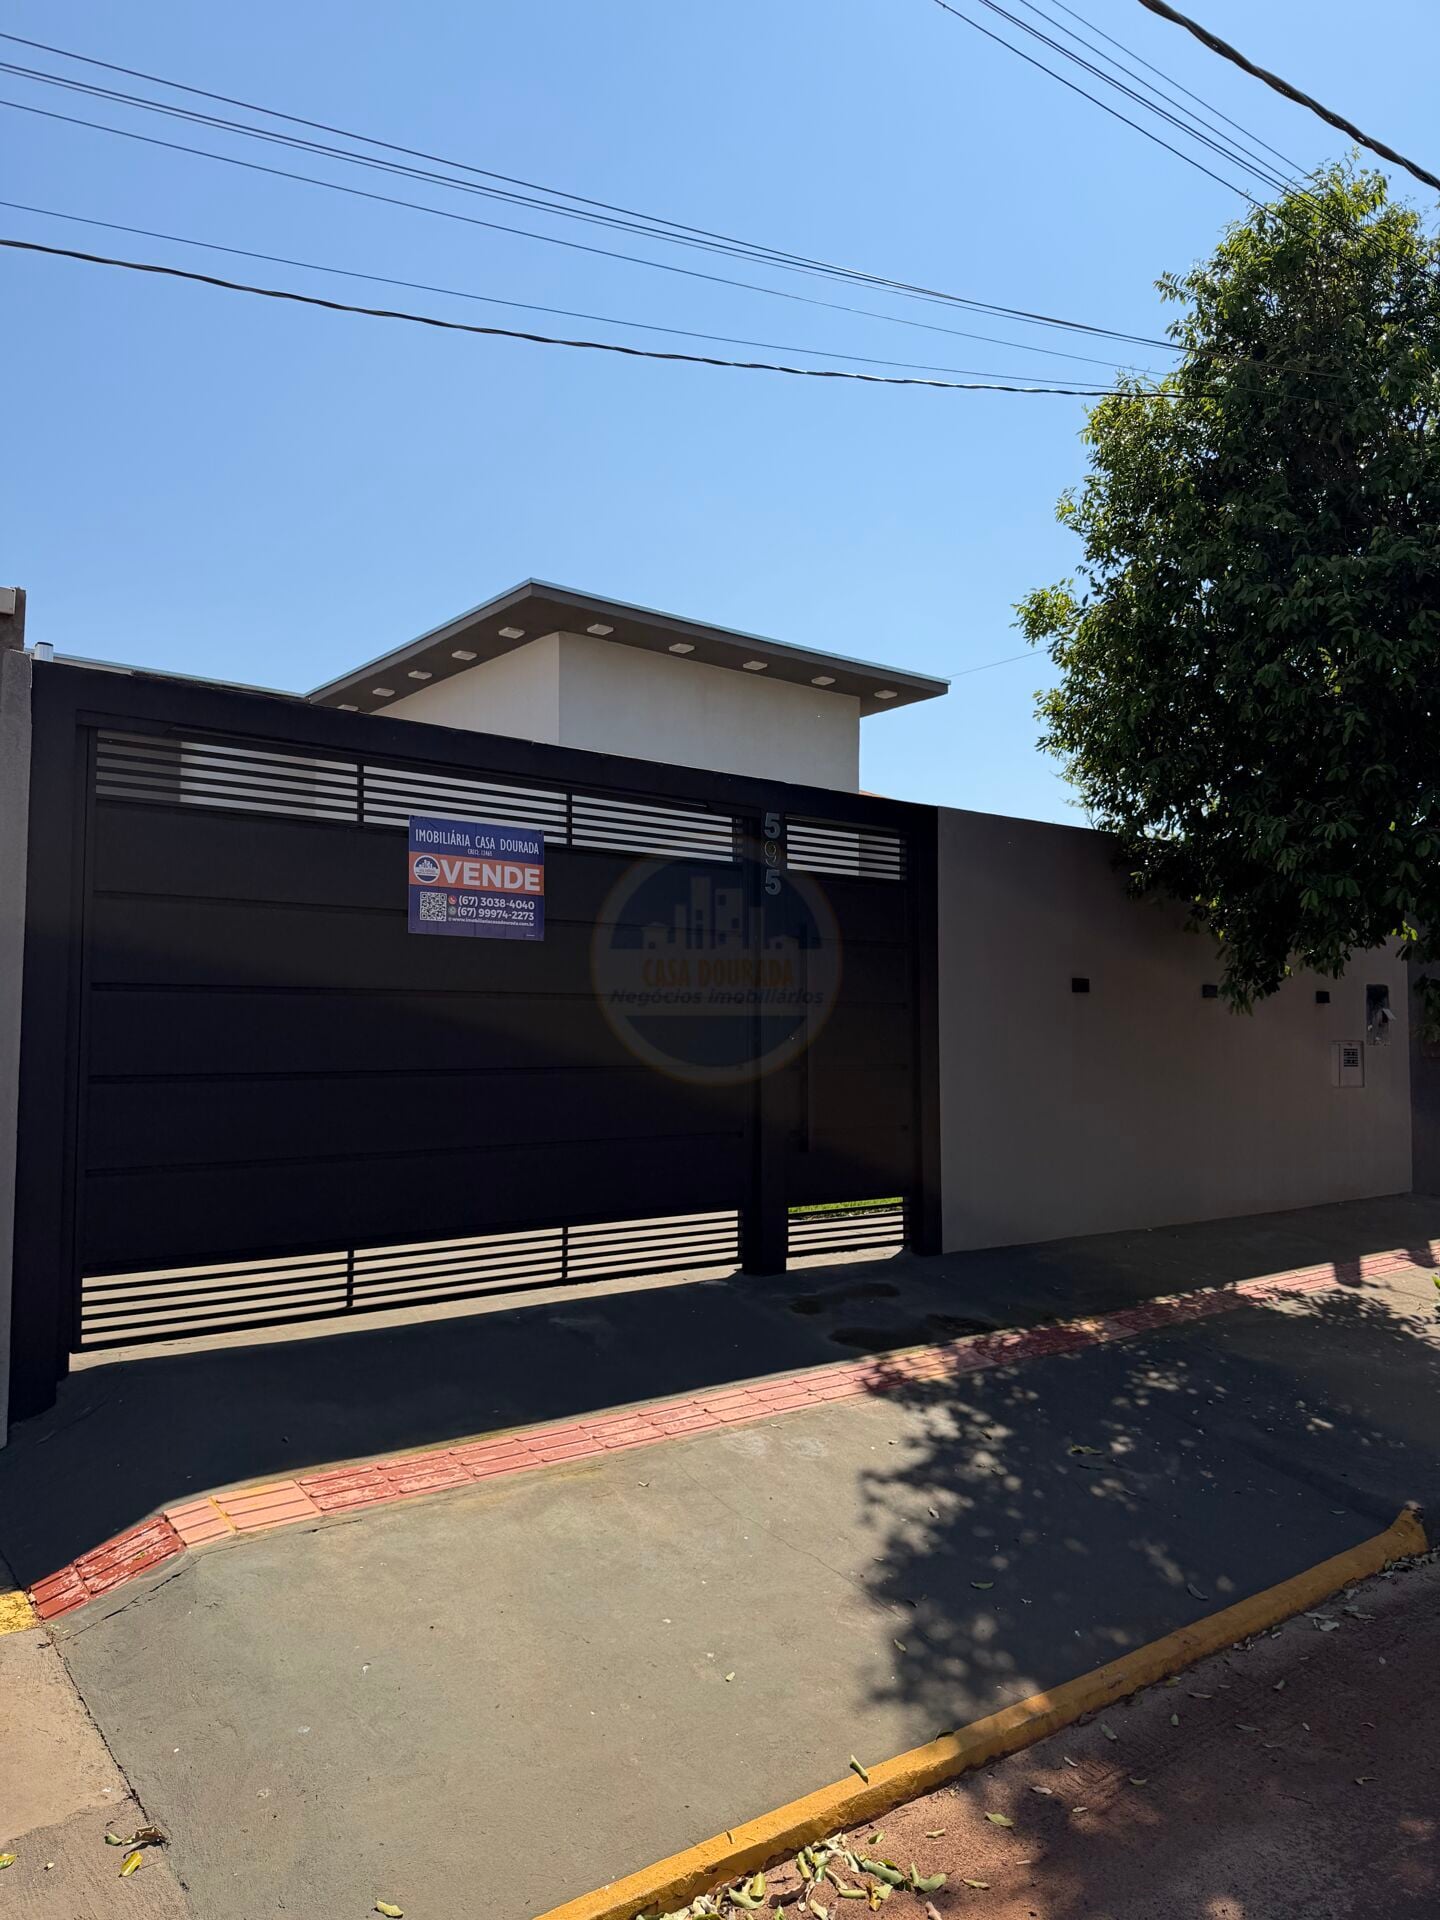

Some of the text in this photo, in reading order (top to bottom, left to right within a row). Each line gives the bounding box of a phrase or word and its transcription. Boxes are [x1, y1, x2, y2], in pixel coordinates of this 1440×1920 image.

[415, 829, 539, 855] IMOBILIÁRIA CASA DOURADA
[441, 859, 541, 892] VENDE
[457, 905, 535, 921] (67) 99974-2273
[458, 895, 535, 910] (67) 3038-4040
